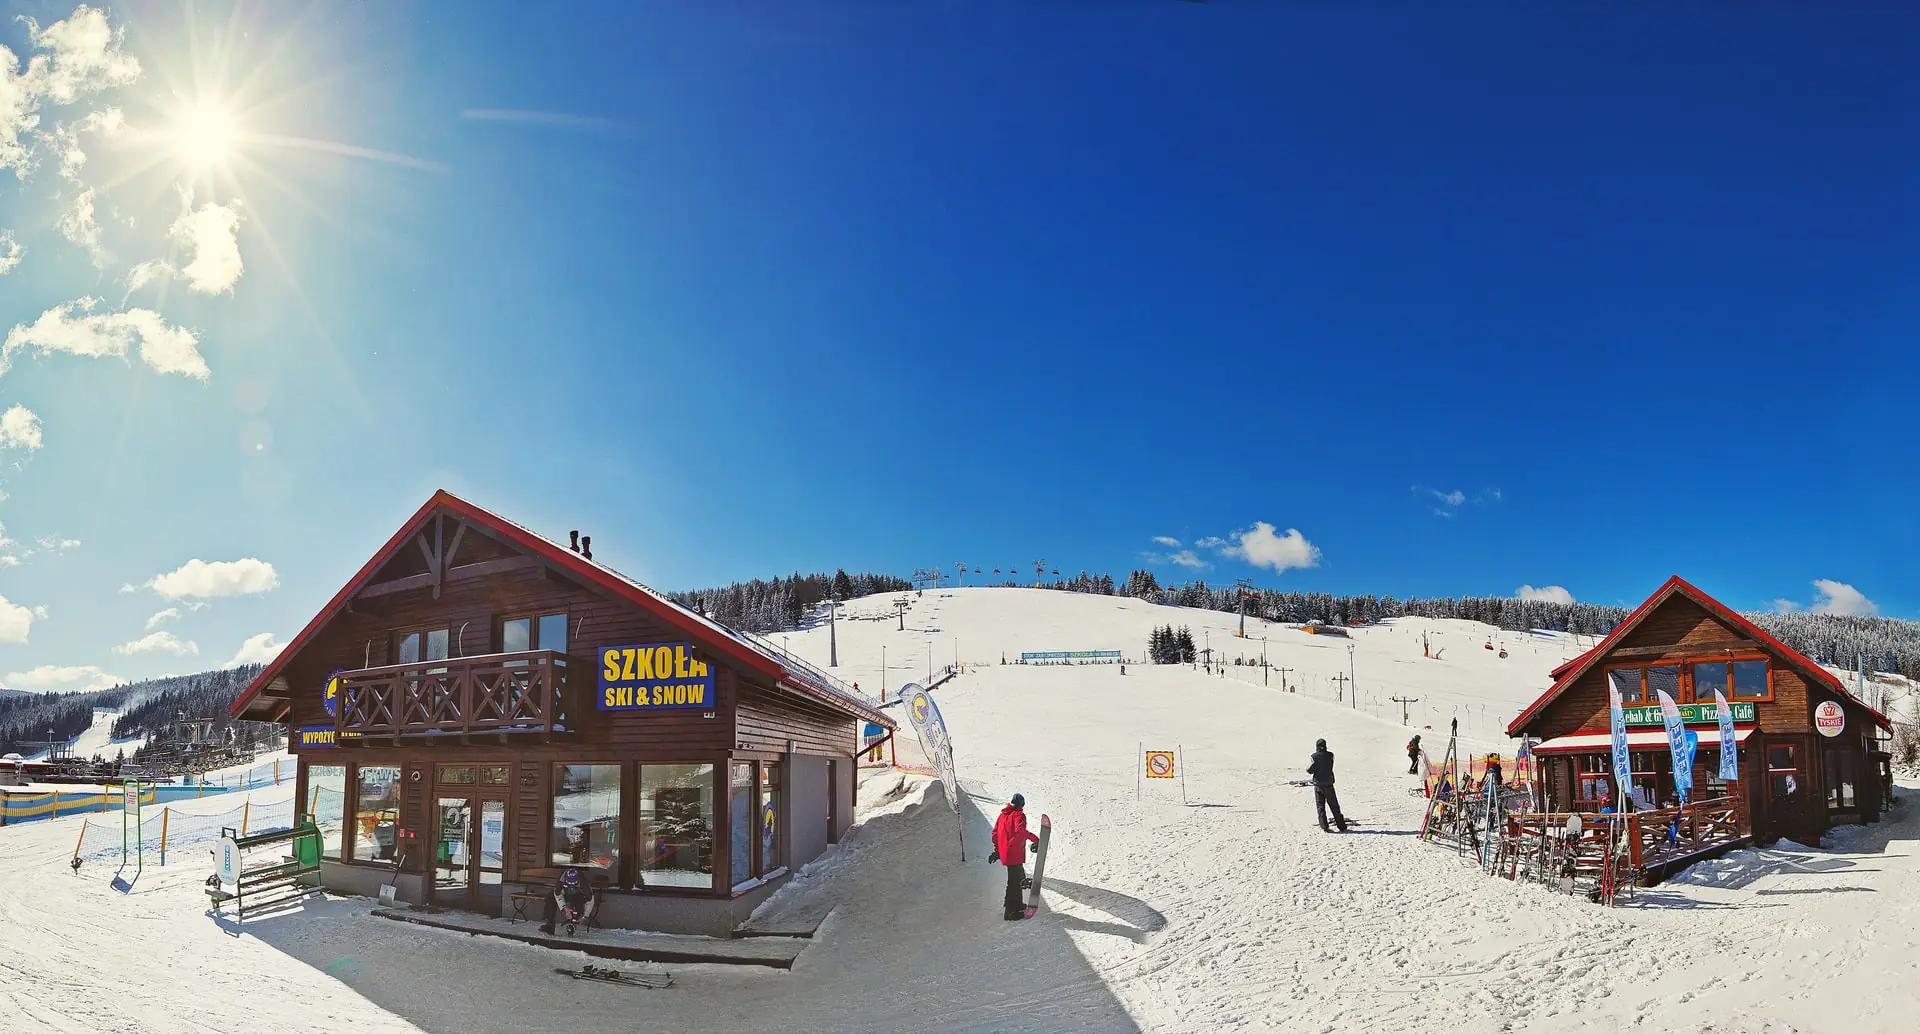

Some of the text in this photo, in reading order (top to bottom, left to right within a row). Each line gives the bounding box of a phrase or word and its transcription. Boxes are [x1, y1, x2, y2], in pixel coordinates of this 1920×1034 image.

[604, 646, 708, 681] SZKOŁA
[605, 684, 705, 707] SKI & SNOW
[1624, 710, 1643, 723] ebab
[1702, 707, 1718, 720] Pizz
[1734, 705, 1753, 719] Café
[1818, 718, 1842, 726] TYSKIE
[358, 766, 401, 781] SERWIS
